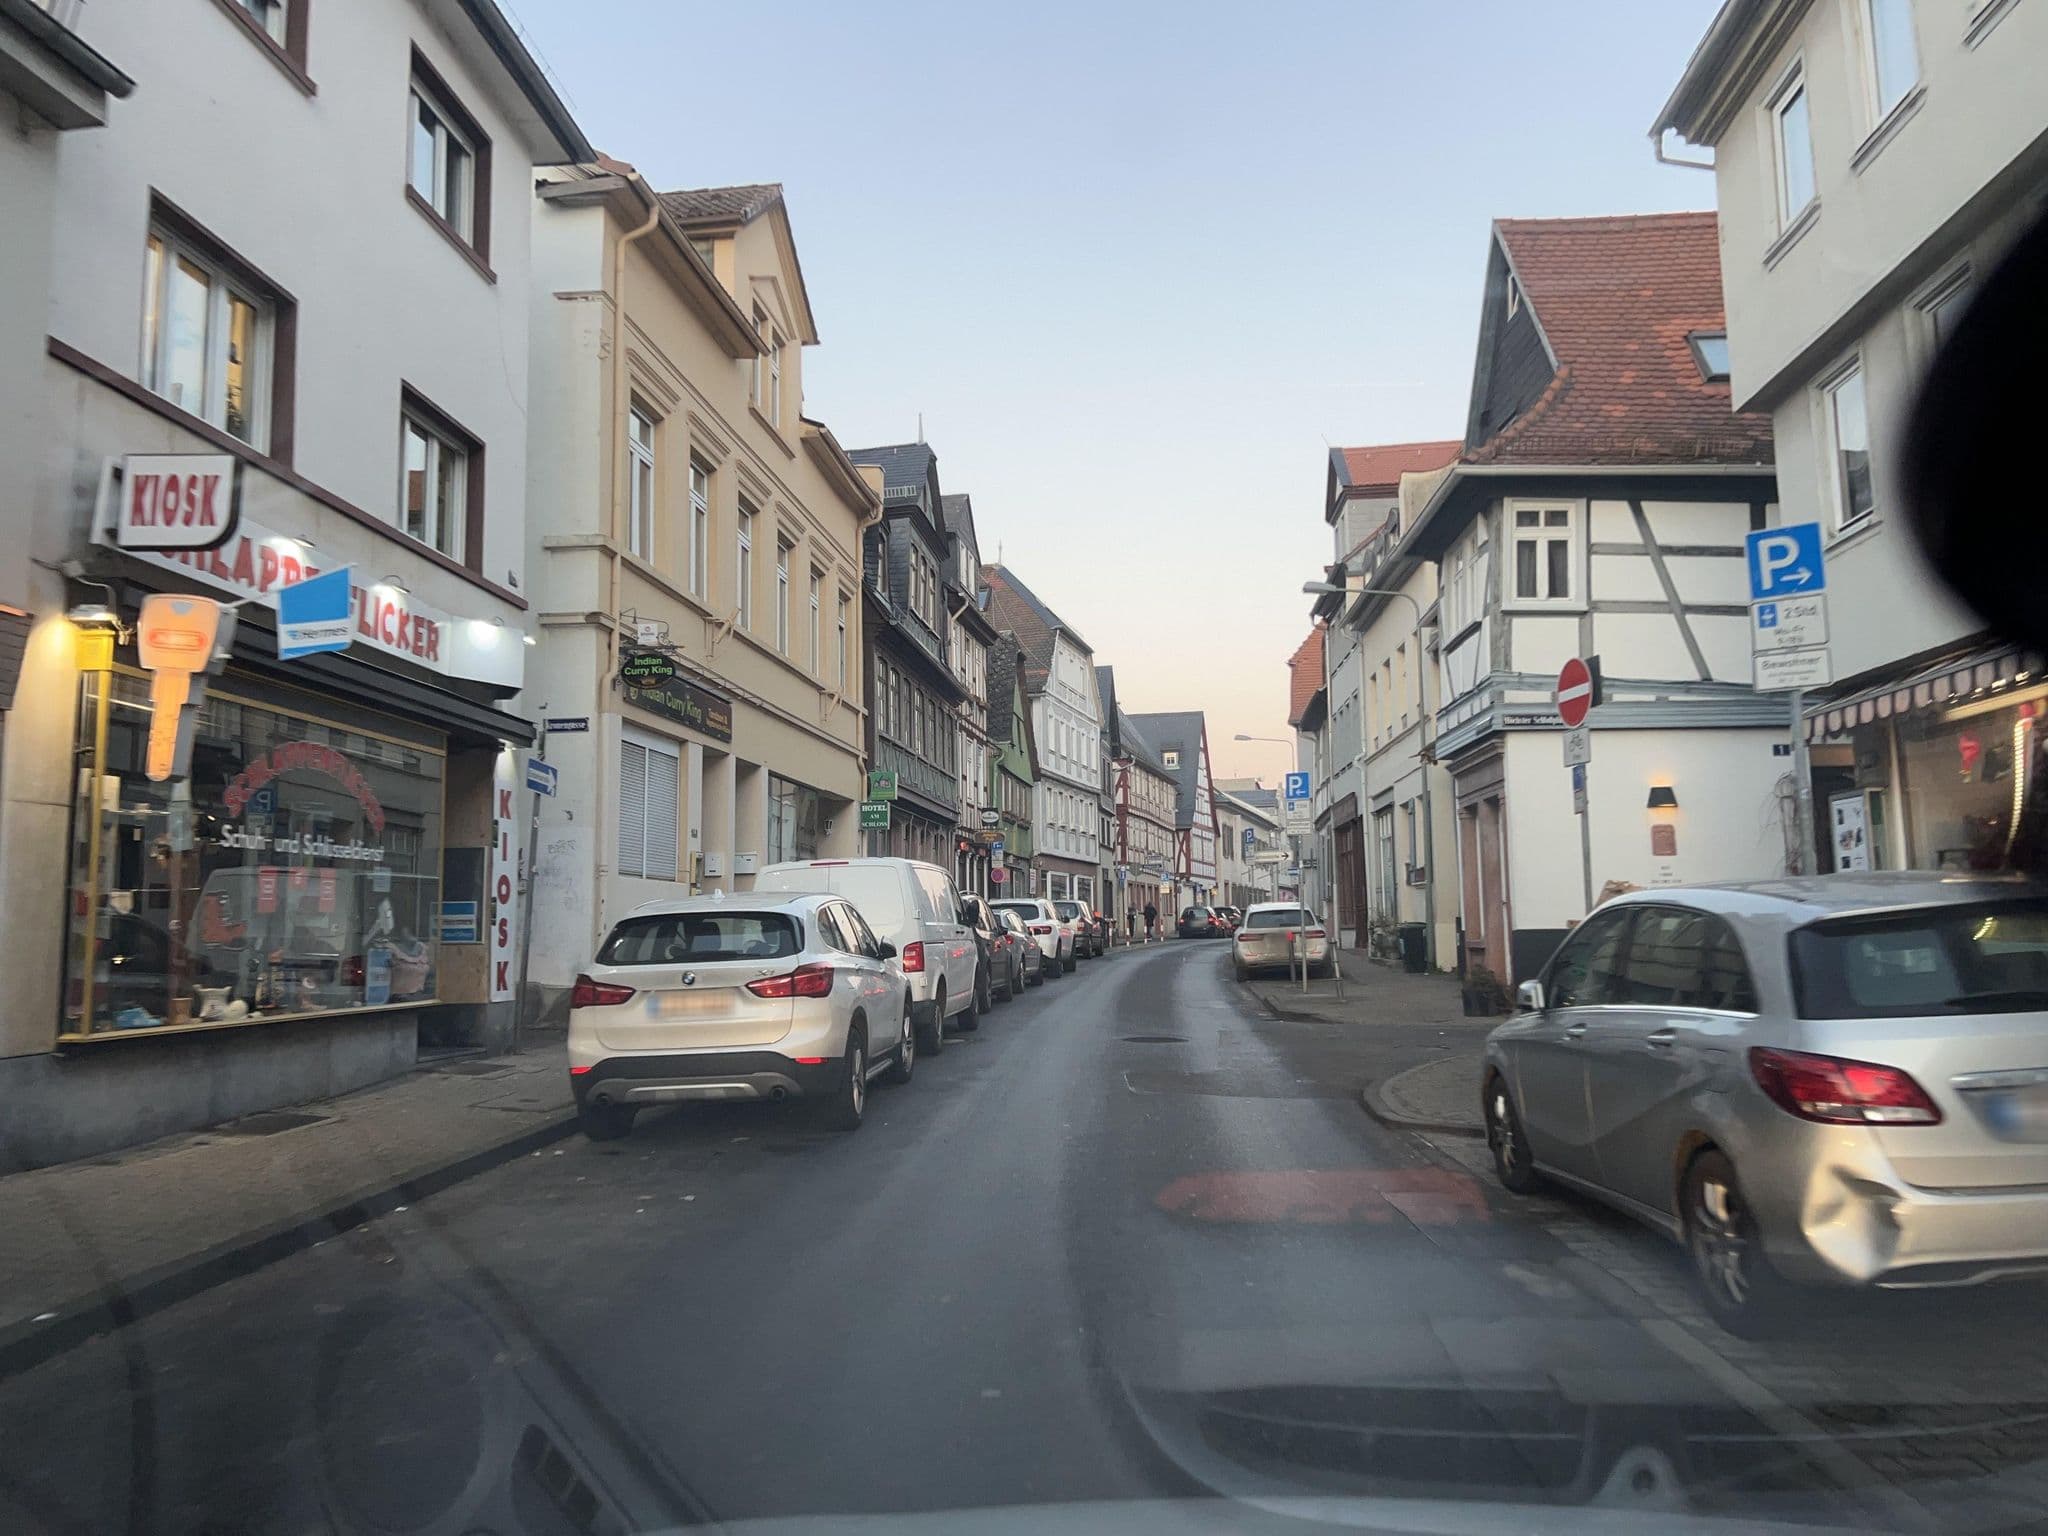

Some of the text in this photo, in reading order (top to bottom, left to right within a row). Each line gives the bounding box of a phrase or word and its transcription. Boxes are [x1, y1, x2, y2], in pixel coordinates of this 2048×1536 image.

[129, 474, 222, 528] KIOSK
[1757, 535, 1800, 591] P
[624, 665, 673, 677] Curry King
[634, 657, 663, 666] Indian
[665, 691, 687, 716] Curry
[686, 697, 702, 724] King
[1289, 776, 1302, 797] P
[274, 831, 300, 854] und
[497, 789, 512, 992] KIOSK
